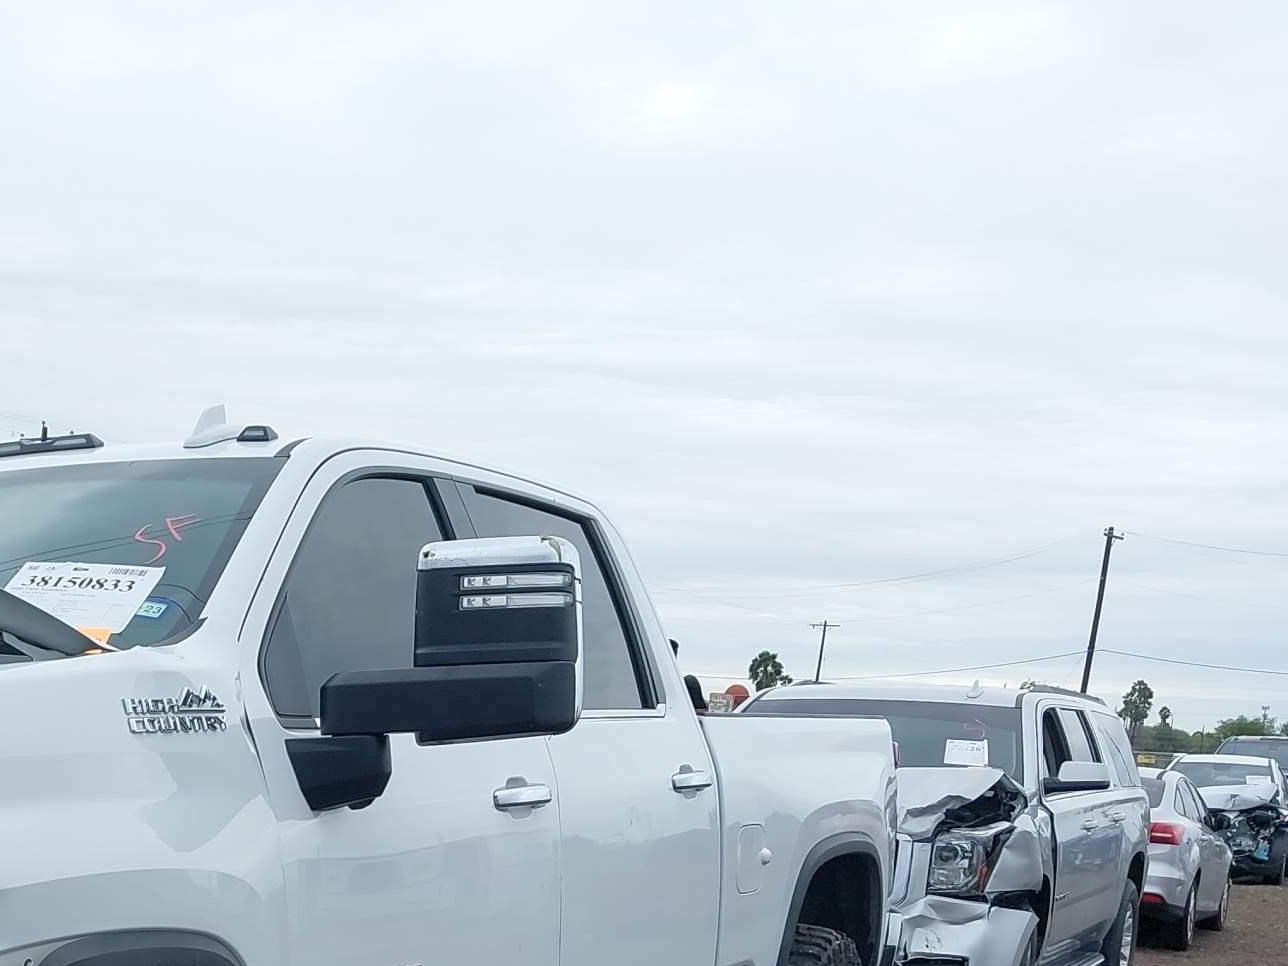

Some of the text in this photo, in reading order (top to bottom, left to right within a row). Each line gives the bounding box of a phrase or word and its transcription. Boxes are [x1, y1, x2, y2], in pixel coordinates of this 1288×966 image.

[21, 575, 136, 593] 38150833
[121, 698, 179, 715] HIGH
[128, 715, 227, 734] COUNTRY
